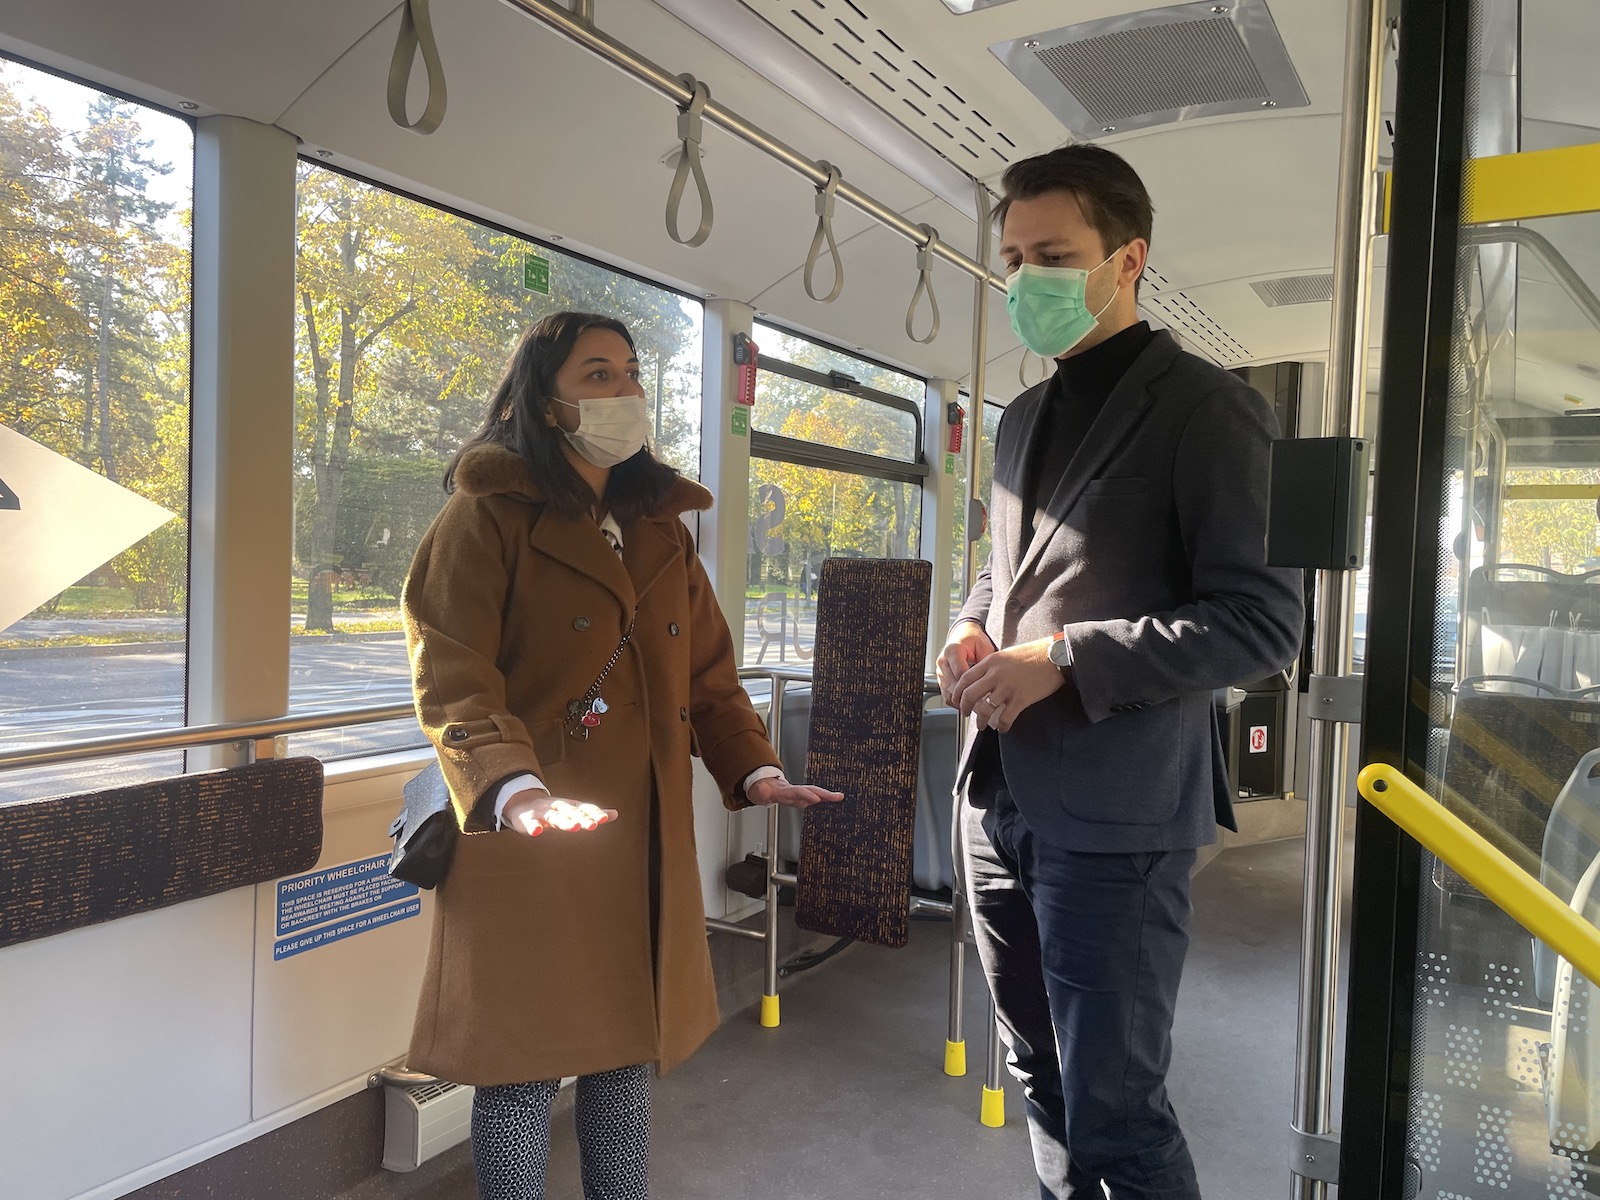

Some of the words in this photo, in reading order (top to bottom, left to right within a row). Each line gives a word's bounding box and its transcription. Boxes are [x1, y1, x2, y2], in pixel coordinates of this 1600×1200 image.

[282, 875, 325, 894] PRIORITY
[327, 859, 385, 881] WHEELCHAIR
[281, 899, 295, 908] THIS
[296, 894, 315, 905] SPACE
[323, 883, 353, 896] RESERVED
[354, 880, 366, 888] FOR
[281, 907, 293, 915] THE
[294, 897, 333, 912] WHEELCHAIR
[333, 891, 350, 902] MUST
[359, 883, 380, 895] PLACED
[281, 907, 318, 922] REARWARDS
[319, 899, 343, 911] RESTING
[345, 893, 368, 904] AGAINST
[381, 881, 405, 893] SUPPORT
[275, 942, 298, 955] PLEASE
[299, 936, 313, 947] GIVE
[314, 934, 322, 942] UP
[323, 929, 336, 939] THIS
[337, 924, 355, 936] SPACE
[355, 920, 367, 929] FOR
[372, 907, 405, 924] WHEELCHAIR
[406, 903, 419, 913] USER
[291, 912, 322, 926] BACKREST
[324, 907, 338, 917] WITH
[351, 899, 373, 909] BRAKES
